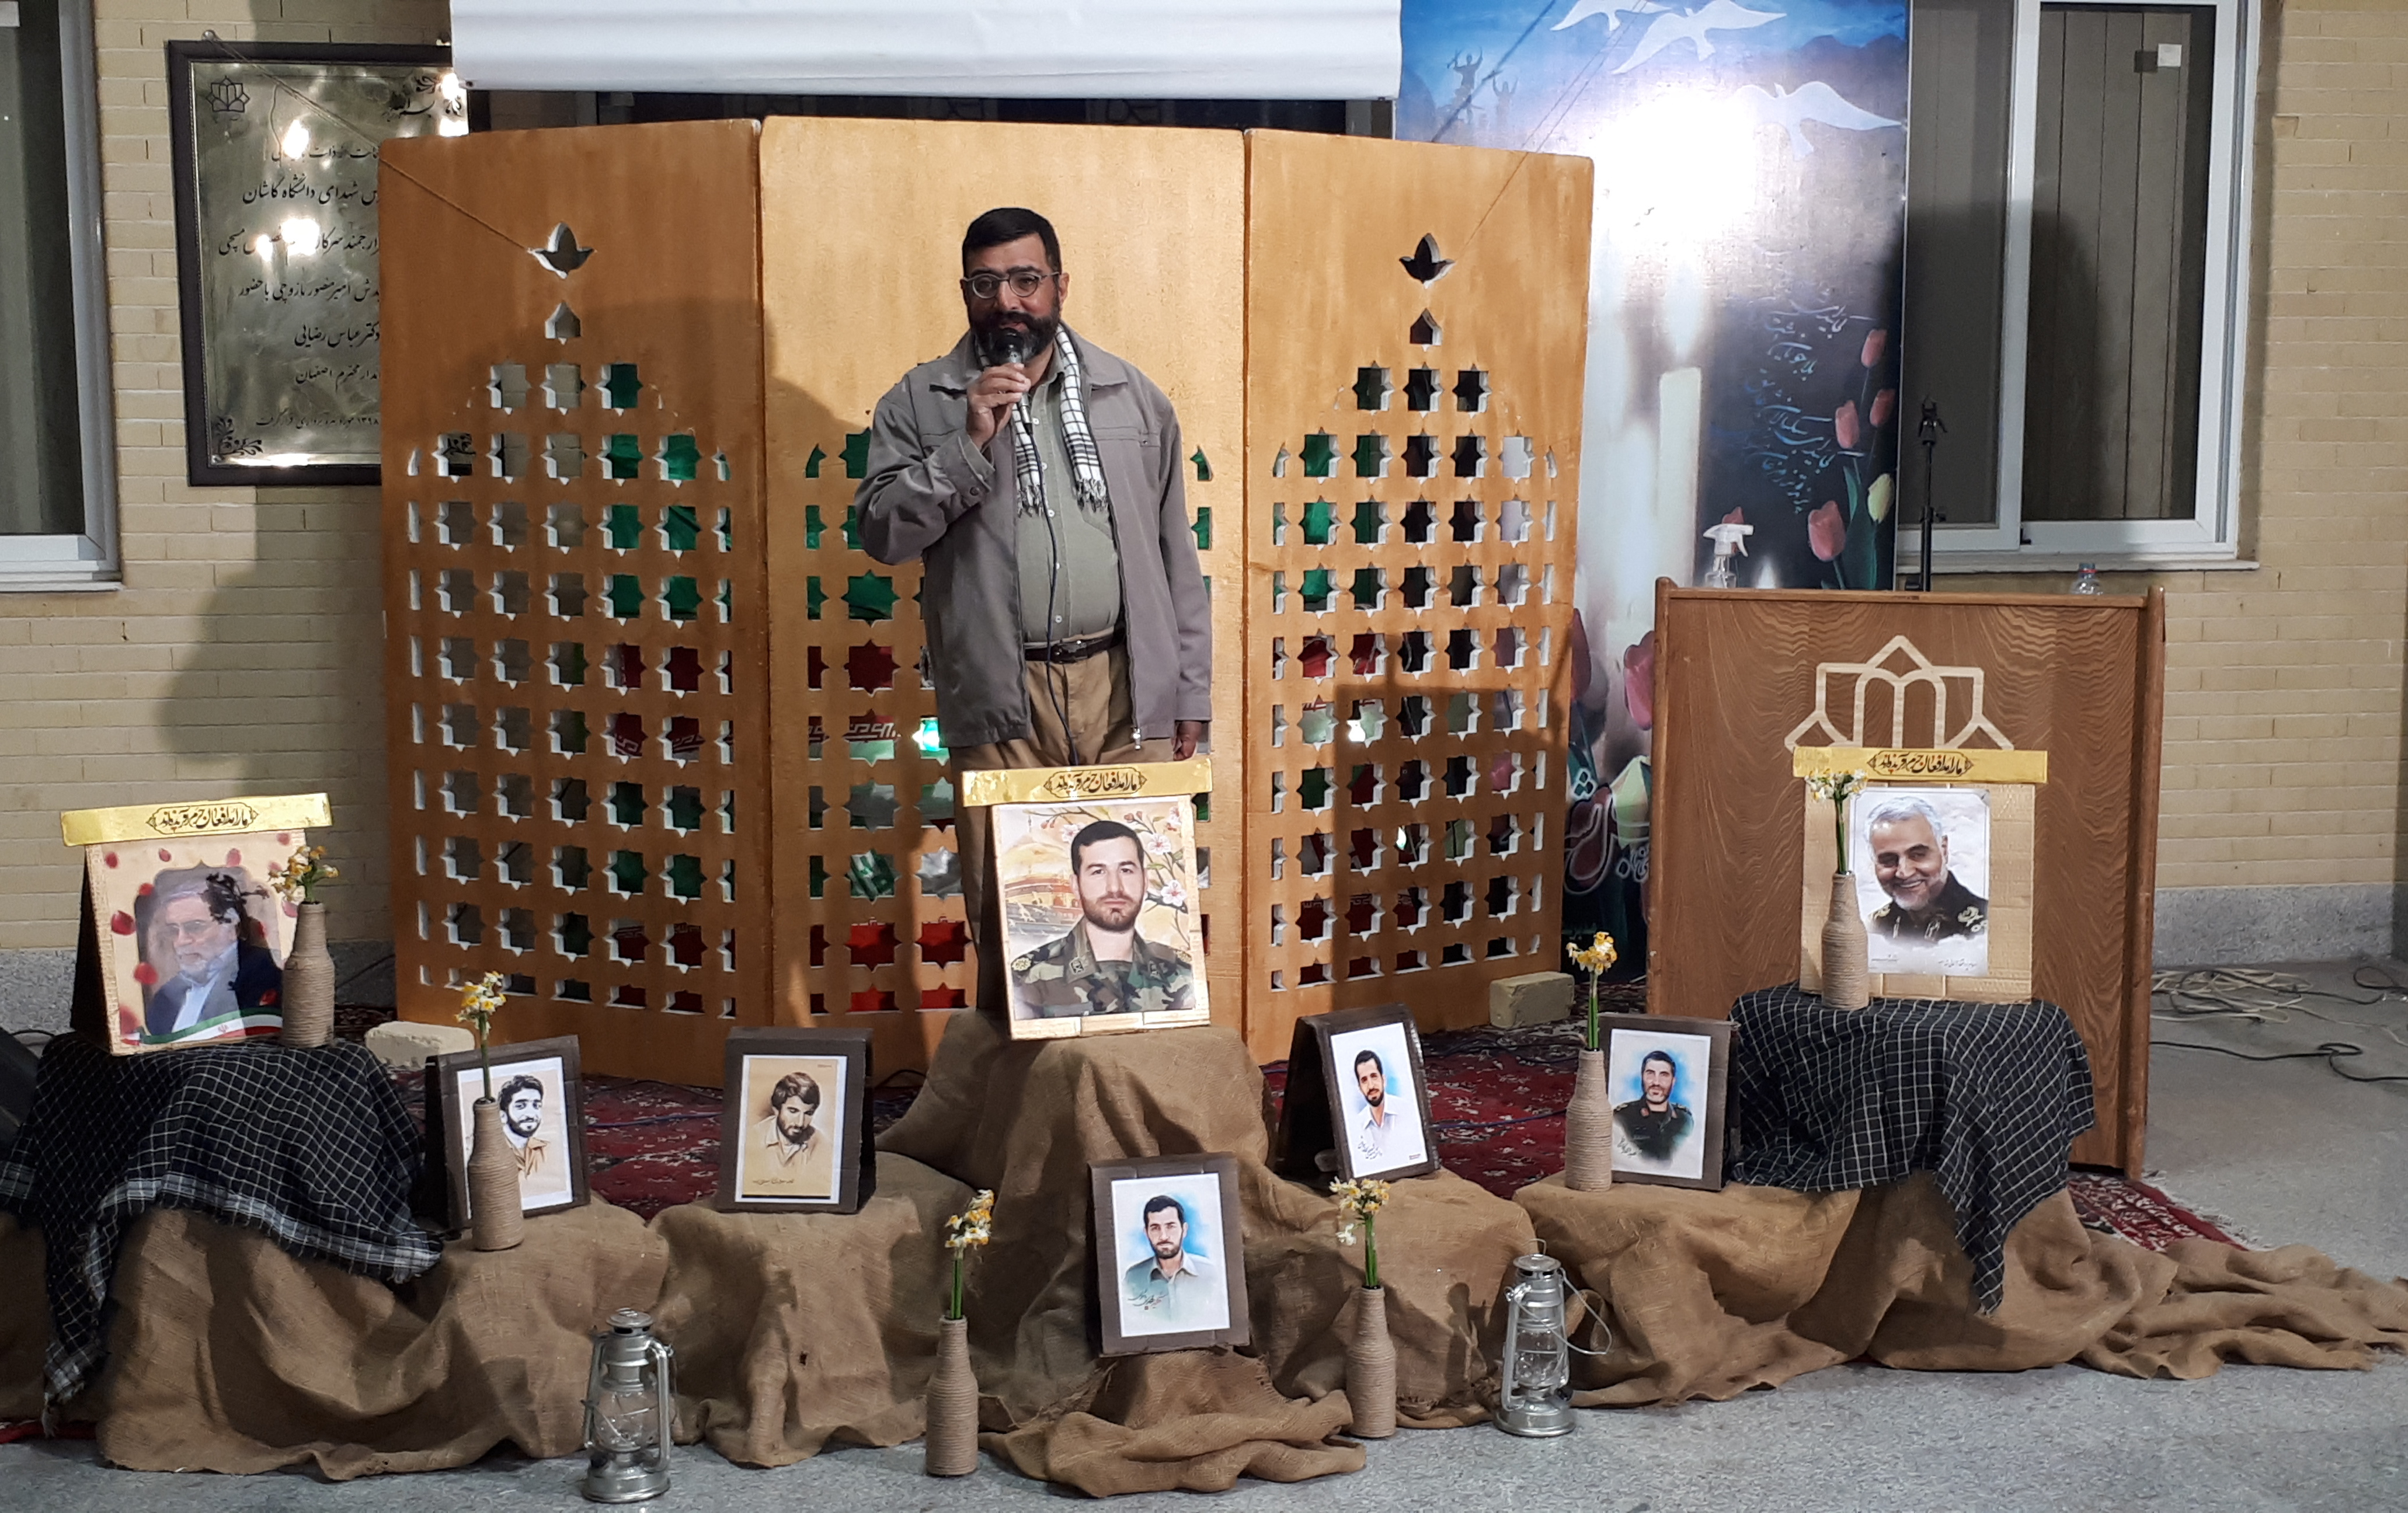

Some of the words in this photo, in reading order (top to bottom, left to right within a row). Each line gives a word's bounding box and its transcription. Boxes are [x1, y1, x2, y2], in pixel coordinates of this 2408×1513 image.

[242, 176, 285, 204] کاشان
[281, 173, 316, 199] دانشگاه
[319, 180, 358, 205] شهدای
[238, 278, 263, 297] حضور
[327, 327, 361, 348] عباس
[355, 320, 381, 348] دکتر
[295, 365, 332, 385] اصفهان
[335, 364, 360, 394] محترم
